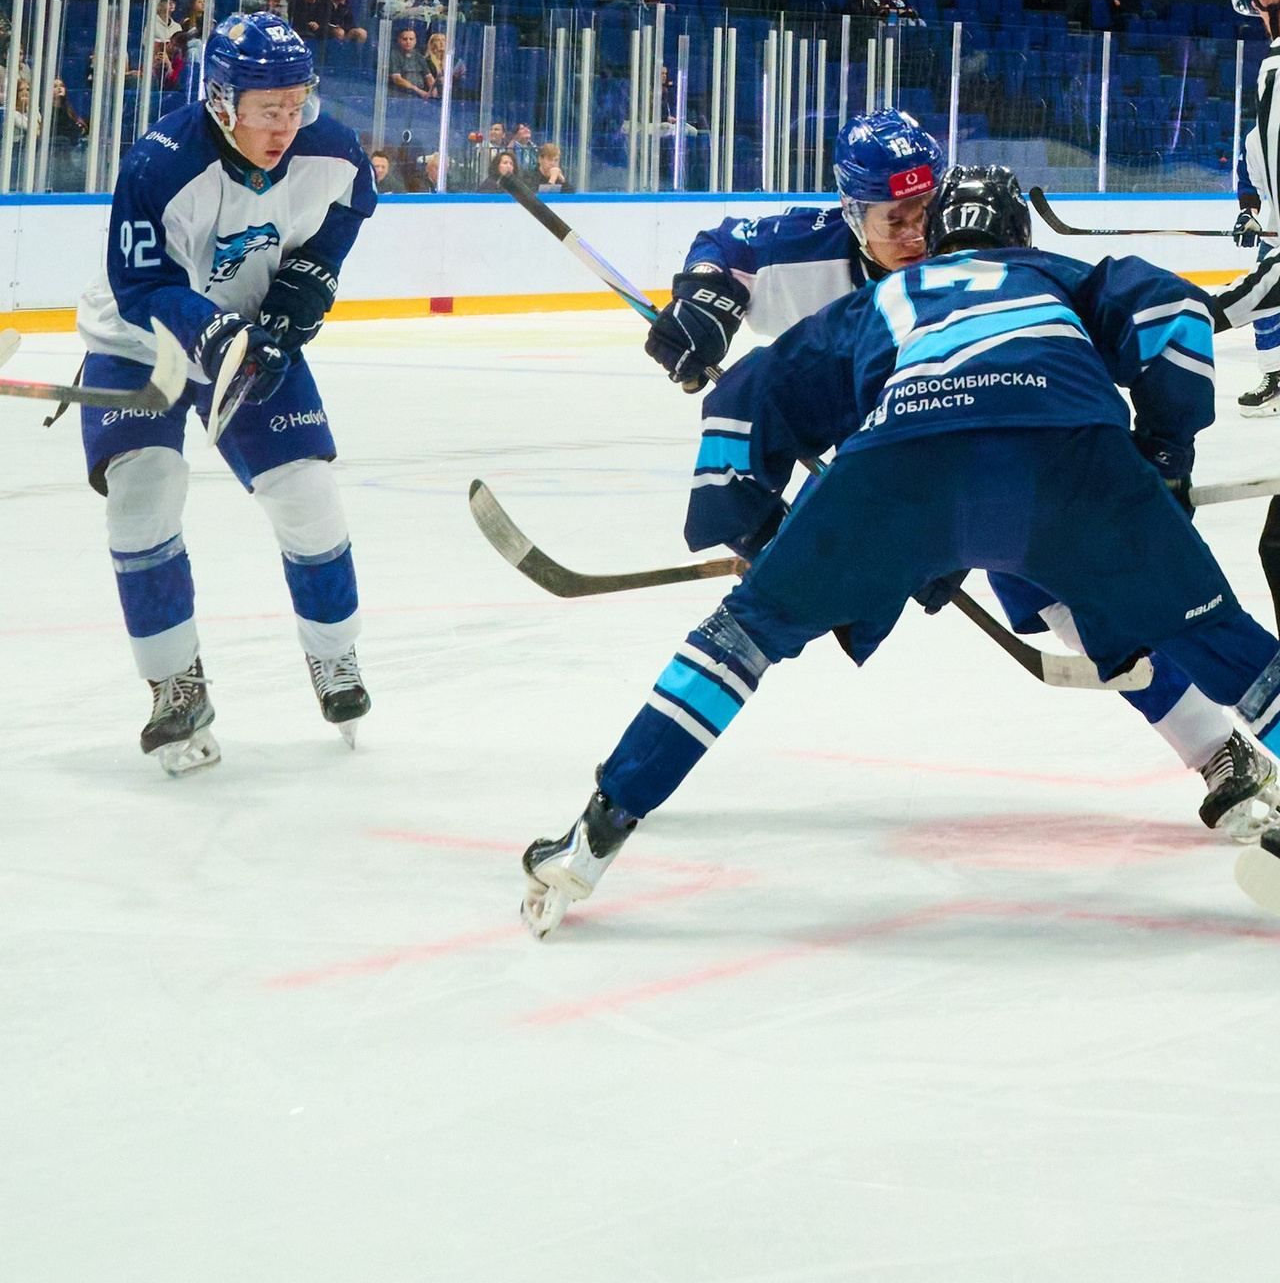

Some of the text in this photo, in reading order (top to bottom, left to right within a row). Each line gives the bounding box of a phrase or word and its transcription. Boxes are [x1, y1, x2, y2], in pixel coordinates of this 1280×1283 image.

[152, 132, 180, 152] Halyk
[894, 180, 932, 197] OLIMPBET
[959, 206, 981, 228] 17
[894, 372, 1047, 399] НОВОСИБИРСКАЯ
[894, 393, 975, 416] ОБЛАСТЬ
[290, 409, 328, 428] Halyk
